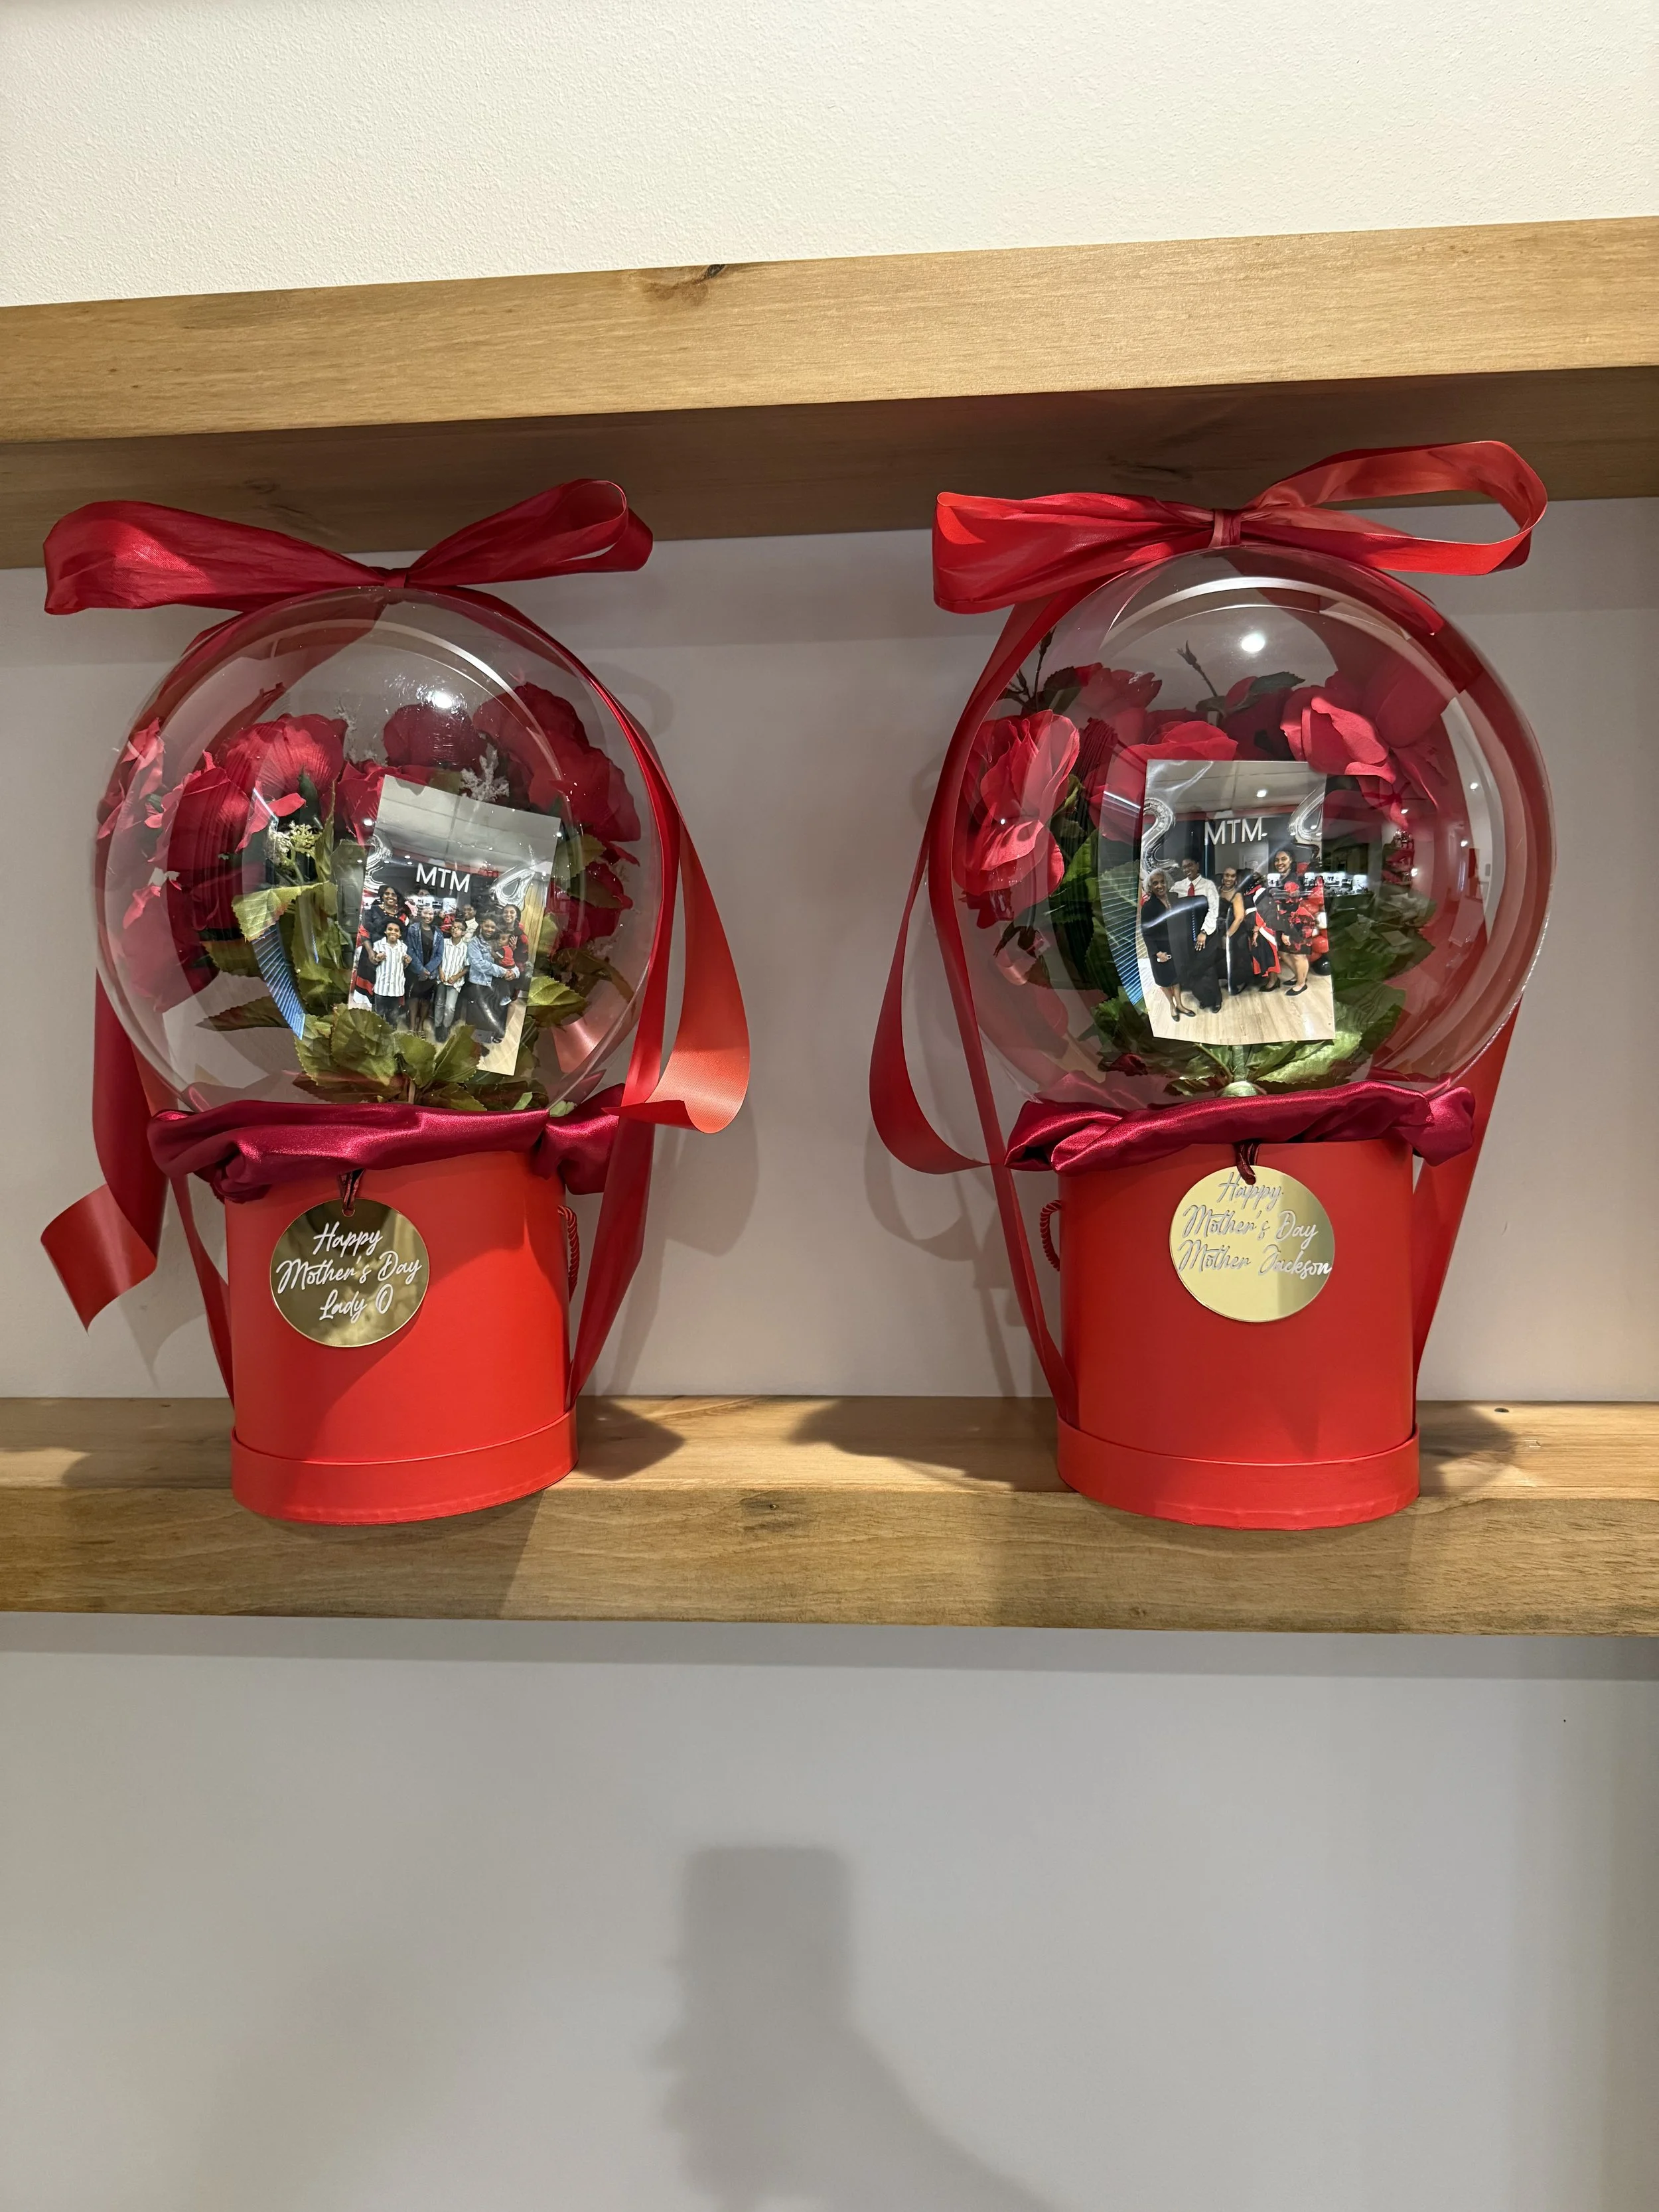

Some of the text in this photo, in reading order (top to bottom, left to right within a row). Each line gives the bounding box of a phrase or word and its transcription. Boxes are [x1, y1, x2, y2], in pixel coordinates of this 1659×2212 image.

[1204, 817, 1262, 846] MTM
[416, 863, 470, 893] MTM
[1216, 1171, 1284, 1211] Happy
[313, 1221, 383, 1258] Happy
[1183, 1205, 1319, 1250] Mother's Day
[276, 1250, 422, 1293] Mother's Day
[1177, 1239, 1332, 1280] Mother Jackson
[319, 1284, 394, 1324] Lady O
